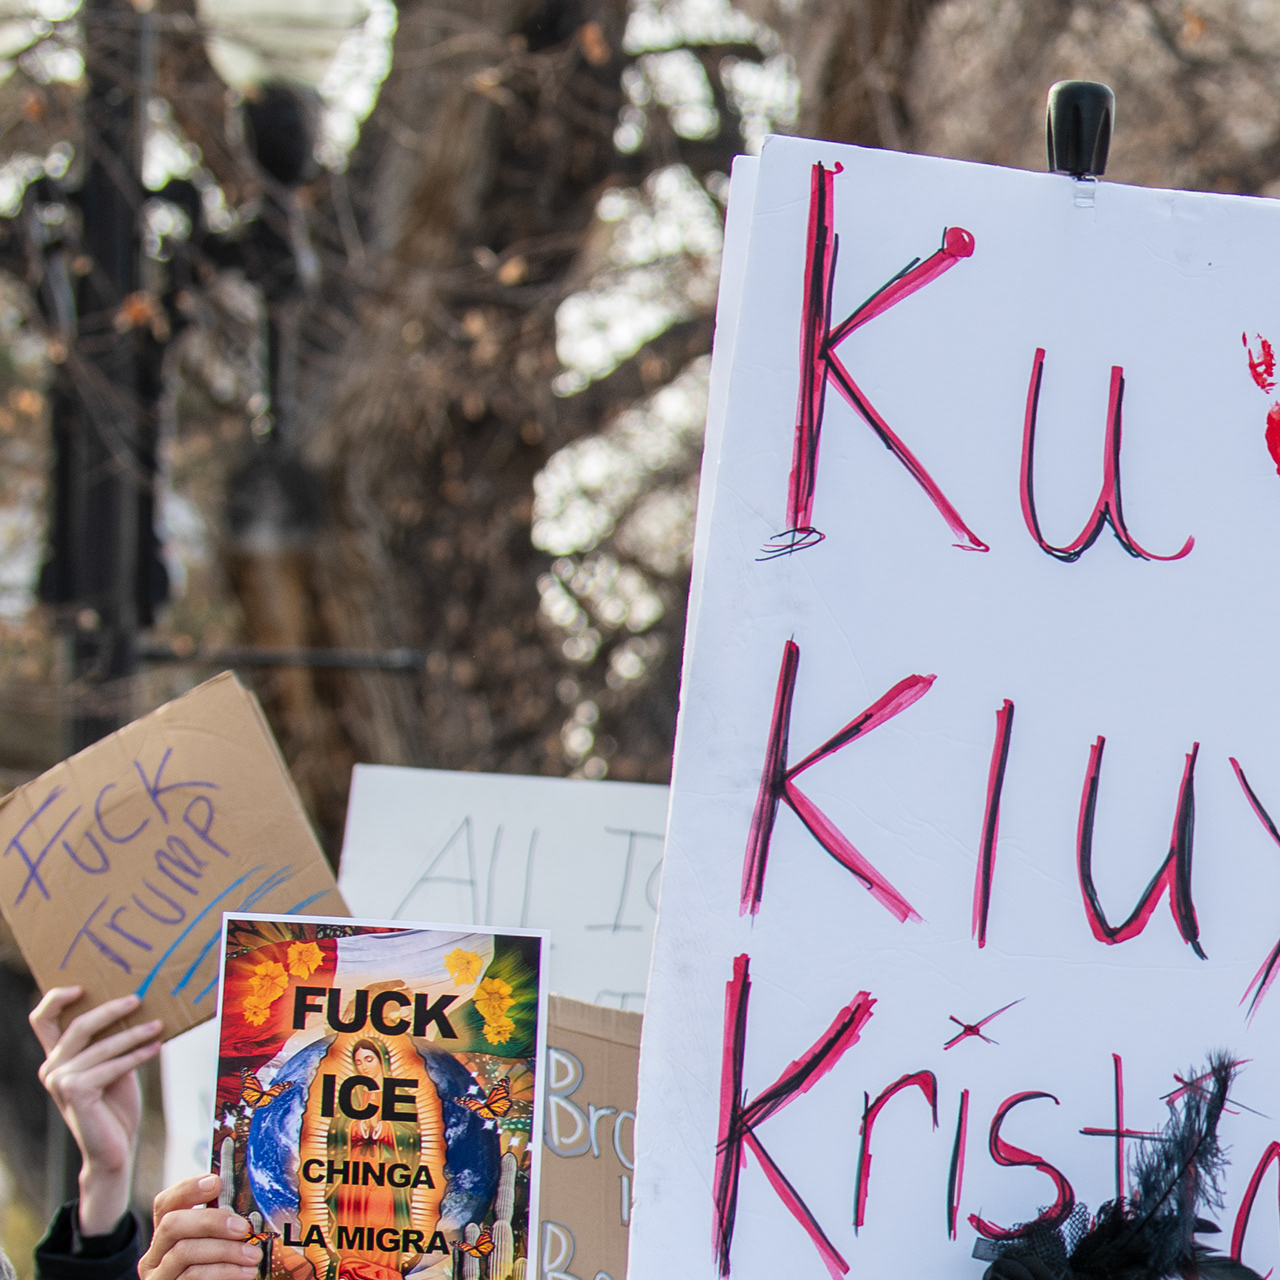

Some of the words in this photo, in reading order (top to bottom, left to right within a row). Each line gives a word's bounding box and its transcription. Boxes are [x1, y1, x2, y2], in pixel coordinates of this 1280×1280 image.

[757, 162, 1196, 563] Ku
[292, 985, 460, 1040] FUCK
[320, 1073, 419, 1123] ICE
[302, 1158, 436, 1190] CHINGA
[282, 1222, 328, 1250] LA
[336, 1225, 451, 1256] MIGRA
